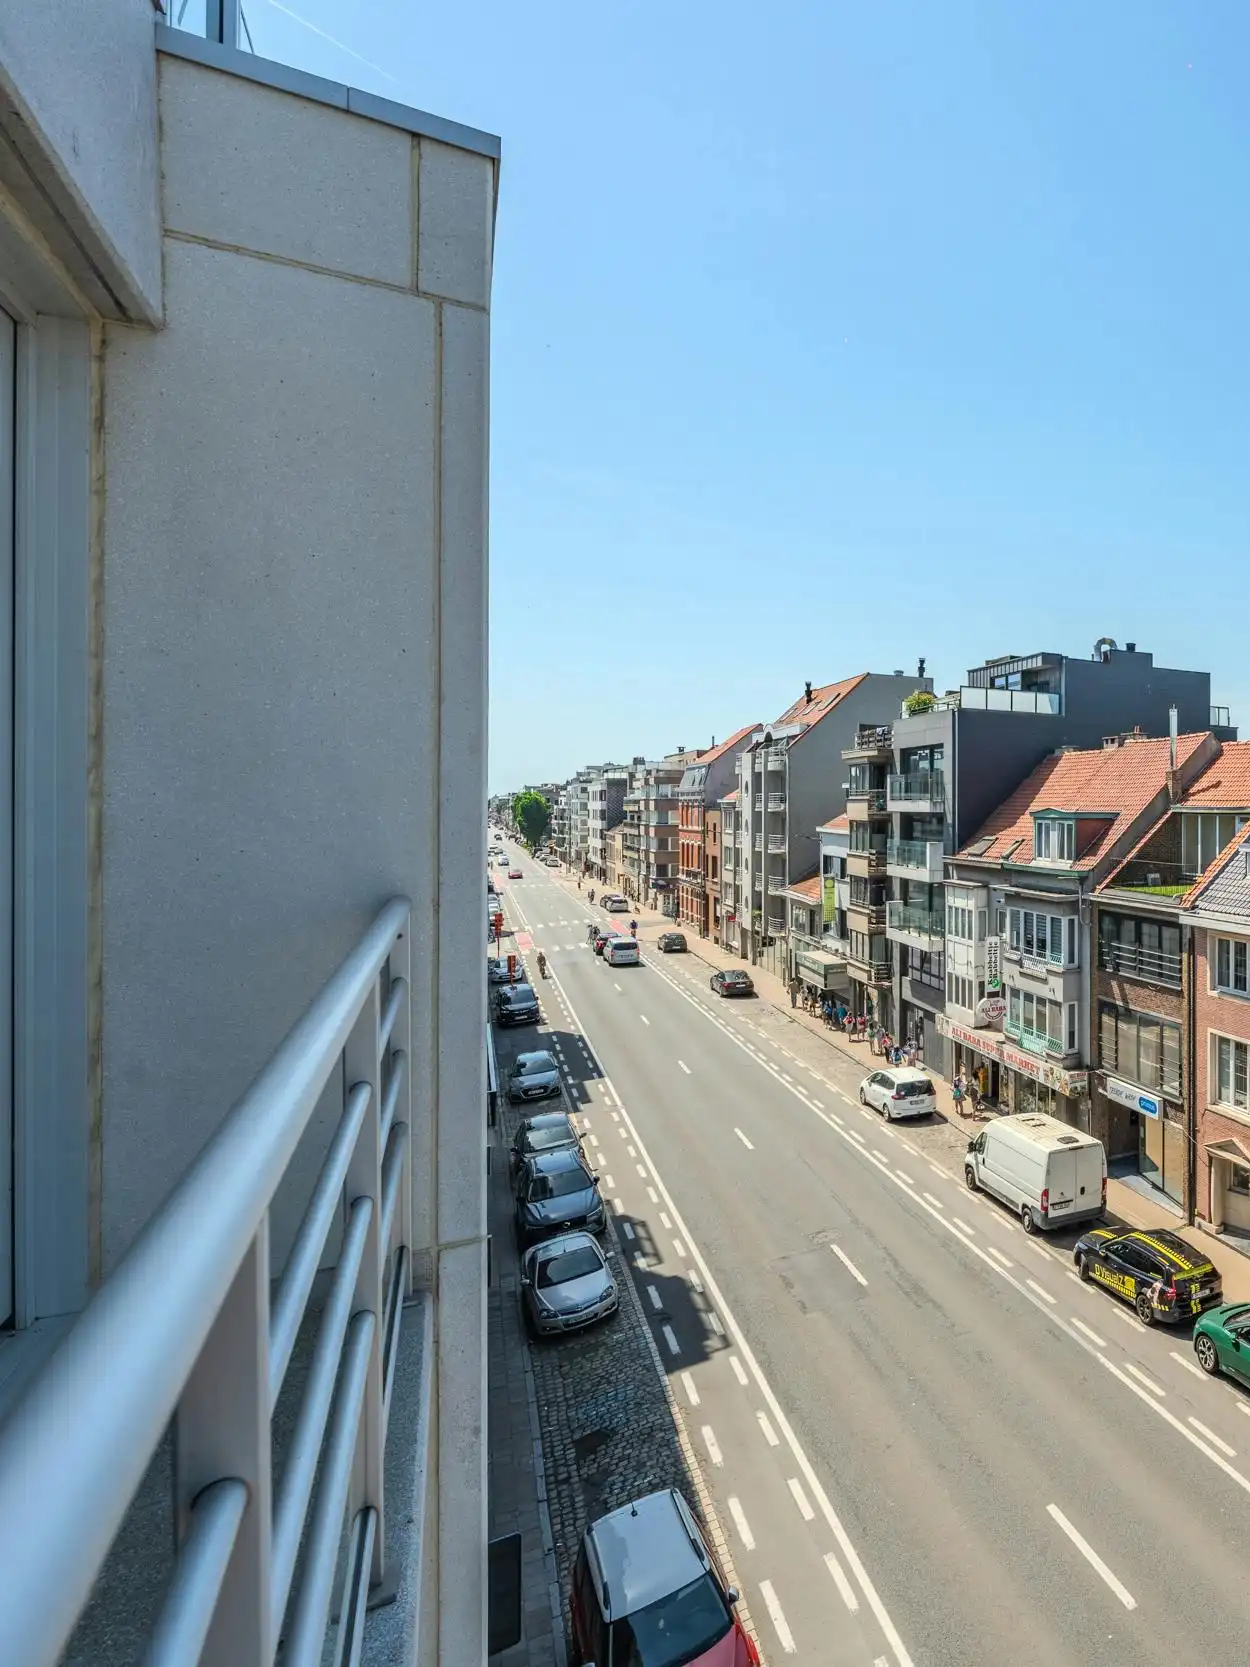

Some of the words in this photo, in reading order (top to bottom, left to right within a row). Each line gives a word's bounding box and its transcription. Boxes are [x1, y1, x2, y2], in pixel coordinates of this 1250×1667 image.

[952, 1027, 962, 1039] ALI
[963, 1032, 981, 1048] BABA
[982, 1041, 1005, 1060] SUPER
[1006, 1051, 1040, 1077] MARKET
